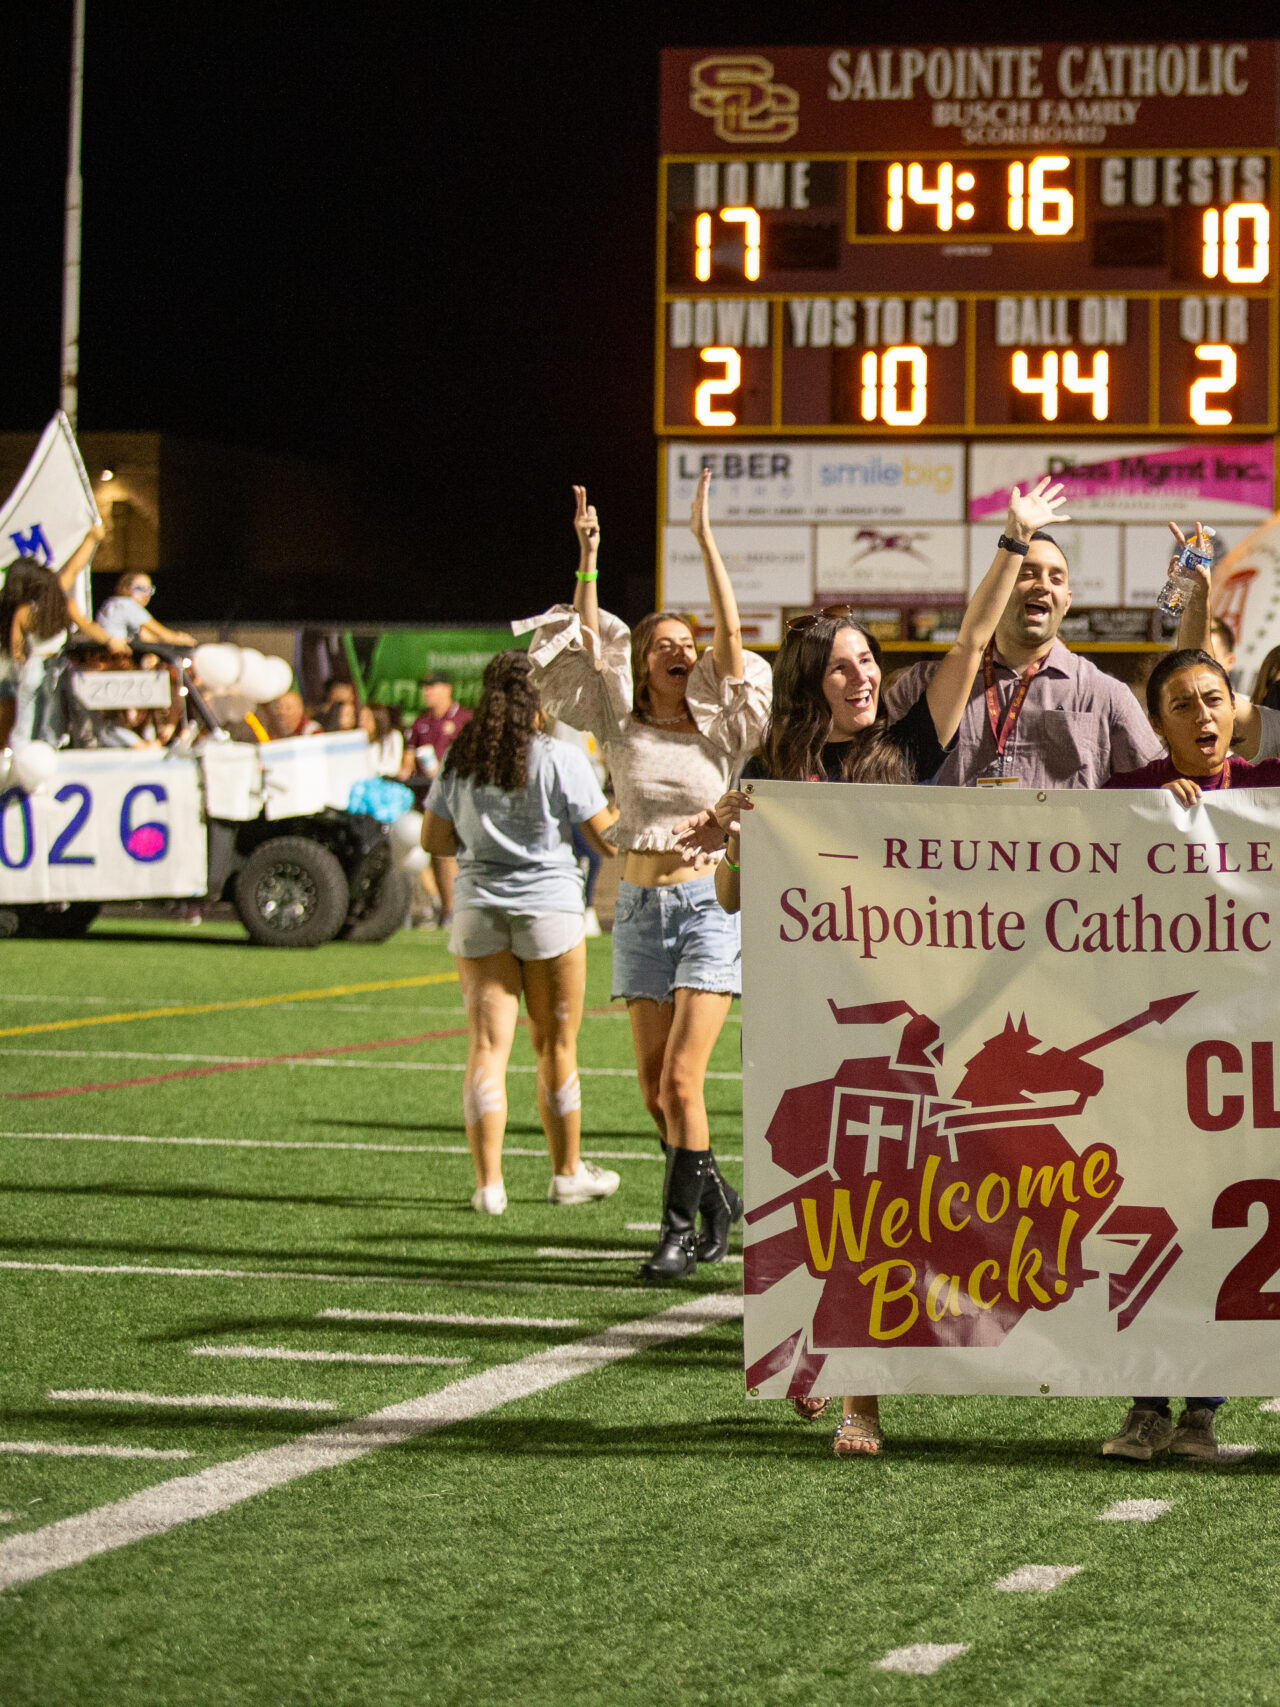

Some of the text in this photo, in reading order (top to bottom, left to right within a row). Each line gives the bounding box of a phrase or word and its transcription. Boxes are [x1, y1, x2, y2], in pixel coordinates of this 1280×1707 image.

[827, 44, 1249, 101] SALPOINTE CATHOLIC
[932, 100, 1142, 128] BUSCH FAMILY
[695, 161, 810, 210] HOME
[1101, 156, 1267, 206] GUESTS
[695, 206, 761, 282] 17
[1202, 202, 1271, 284] 10
[671, 299, 769, 348] DOWN
[790, 298, 958, 347] YDS TO GO
[996, 296, 1127, 347] BALL ON
[1180, 296, 1248, 346] QTR
[695, 346, 742, 427] 2
[861, 346, 928, 427] 10
[1011, 350, 1110, 421] 44
[1189, 344, 1238, 427] 2
[678, 453, 792, 480] LEBER
[1116, 456, 1205, 487] Mgmt
[1213, 456, 1268, 481] Inc.
[884, 836, 1123, 875] REUNION
[779, 886, 1026, 960] Salpointe
[1045, 892, 1271, 953] Catholic
[800, 1148, 1116, 1273] Welcome
[858, 1208, 1080, 1341] Back!
